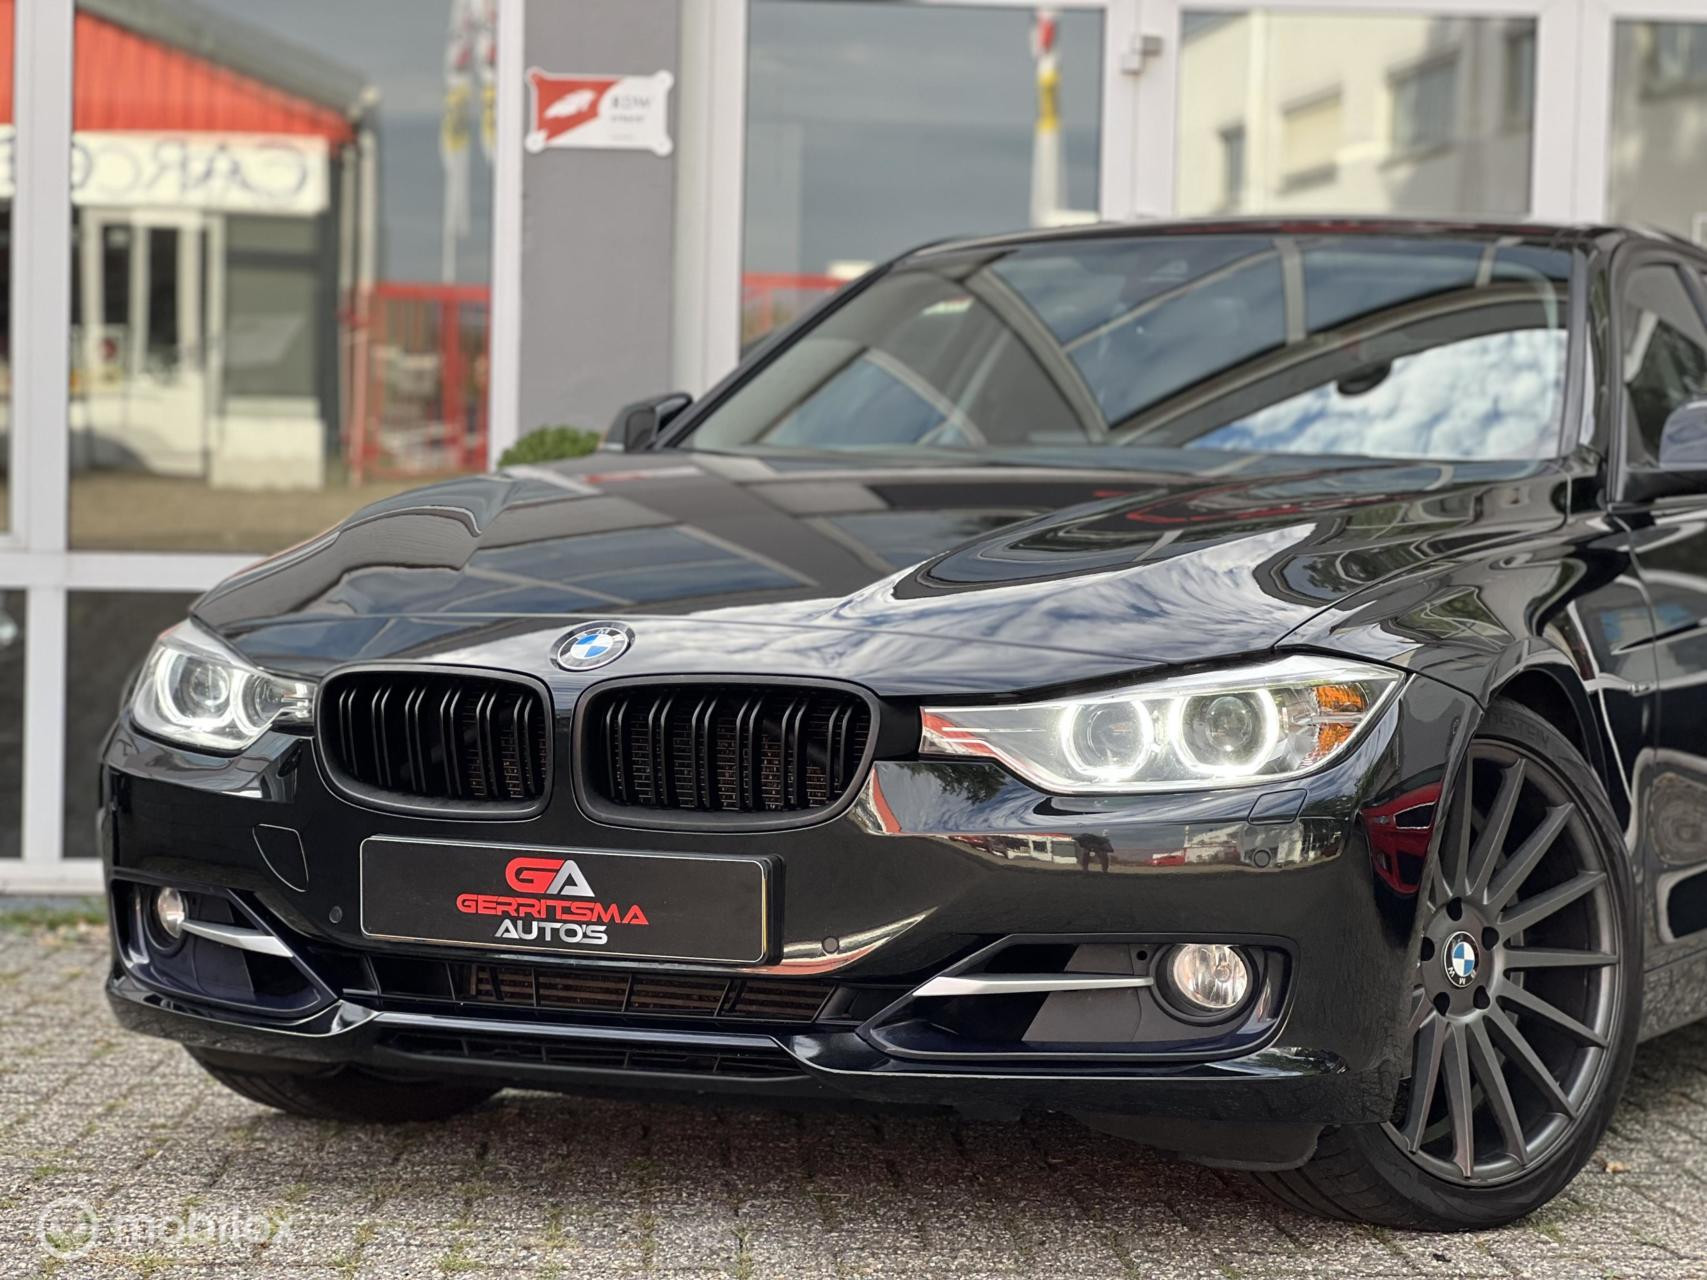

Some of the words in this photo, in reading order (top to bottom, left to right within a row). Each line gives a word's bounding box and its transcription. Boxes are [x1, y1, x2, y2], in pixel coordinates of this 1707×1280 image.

[505, 857, 595, 897] GA
[456, 893, 649, 925] GERRITSMA
[494, 918, 608, 945] AUTO'S
